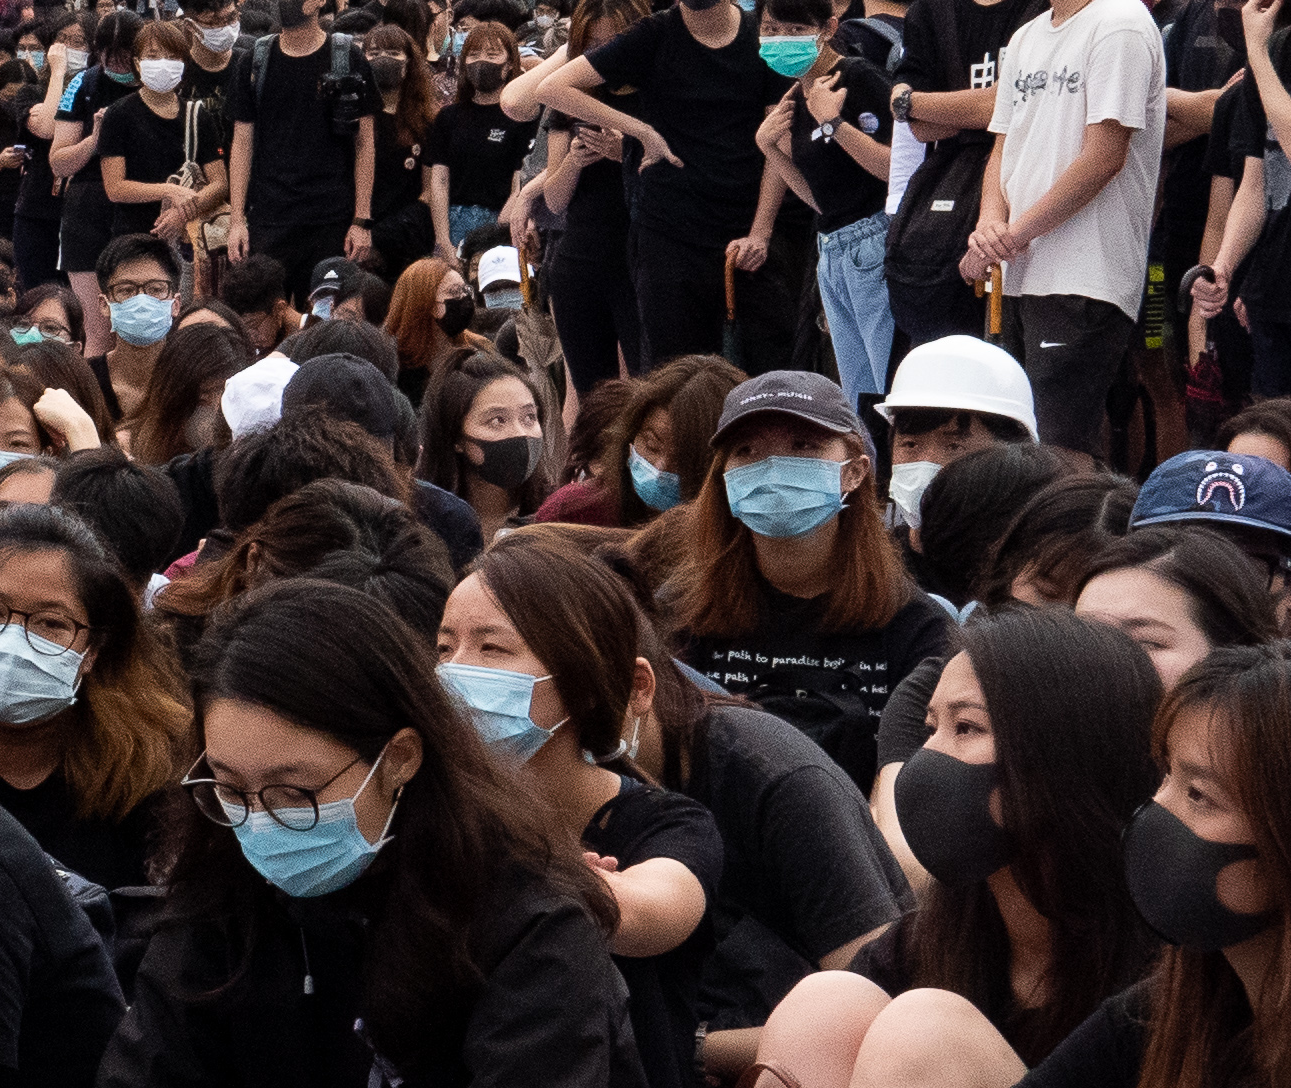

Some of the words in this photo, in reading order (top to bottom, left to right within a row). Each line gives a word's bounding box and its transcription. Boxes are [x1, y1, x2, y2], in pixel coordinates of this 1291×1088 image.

[727, 649, 752, 662] path
[755, 653, 768, 663] to
[772, 655, 820, 668] paradise
[724, 672, 749, 684] path
